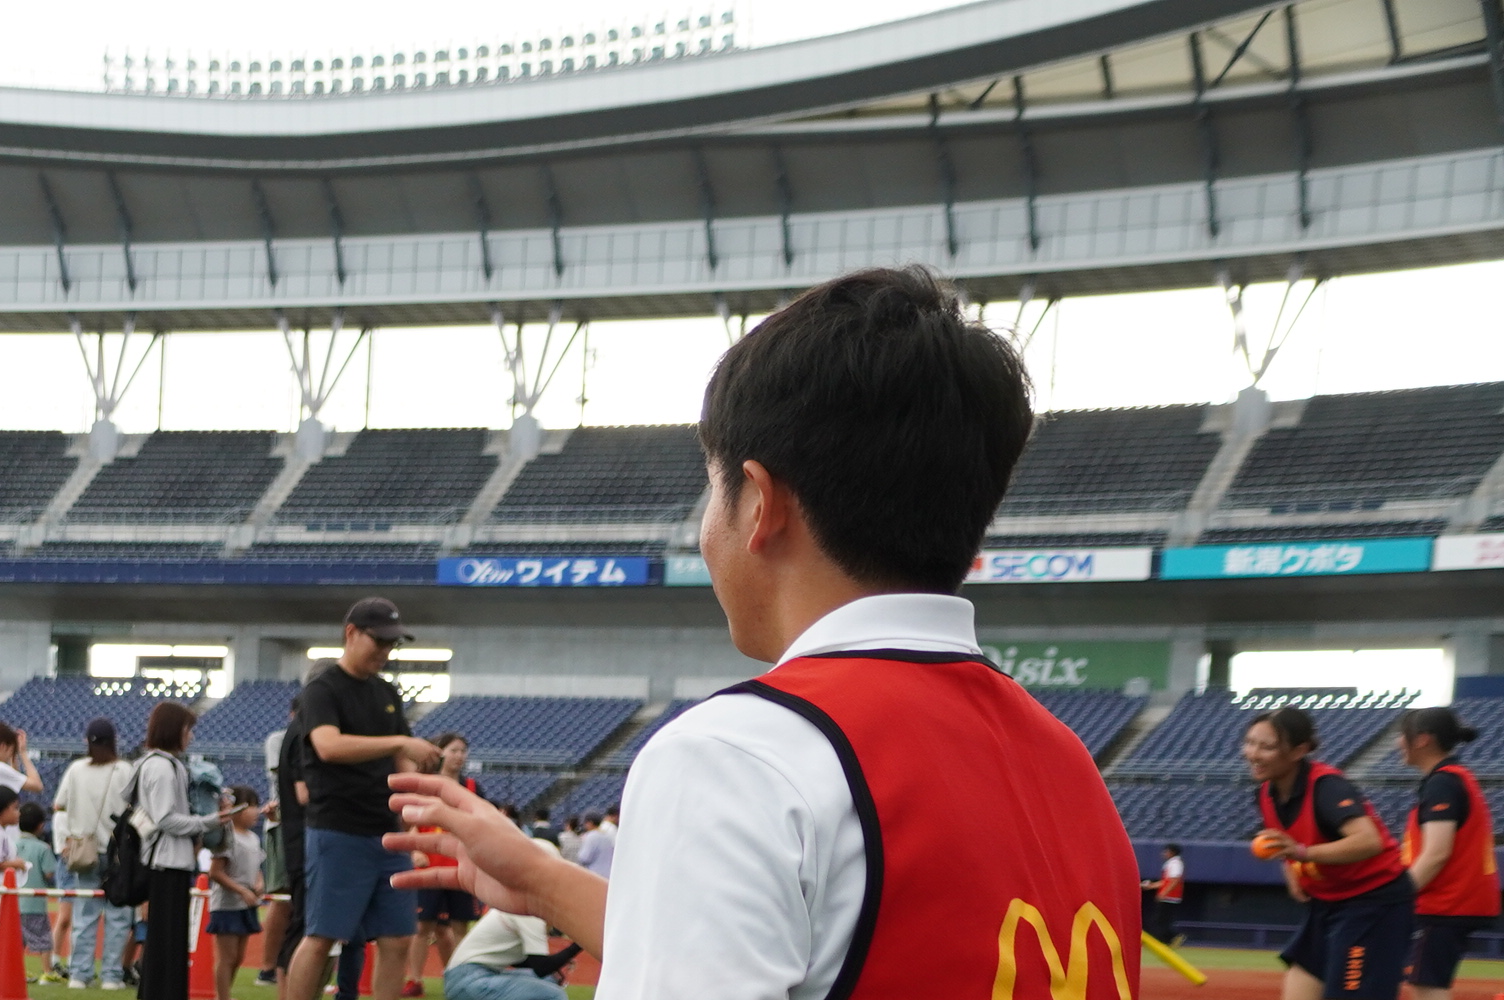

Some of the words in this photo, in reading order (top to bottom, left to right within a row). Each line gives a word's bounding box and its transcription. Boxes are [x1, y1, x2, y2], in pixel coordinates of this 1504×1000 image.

[516, 560, 626, 584] ワイテム
[992, 554, 1094, 577] SECOM
